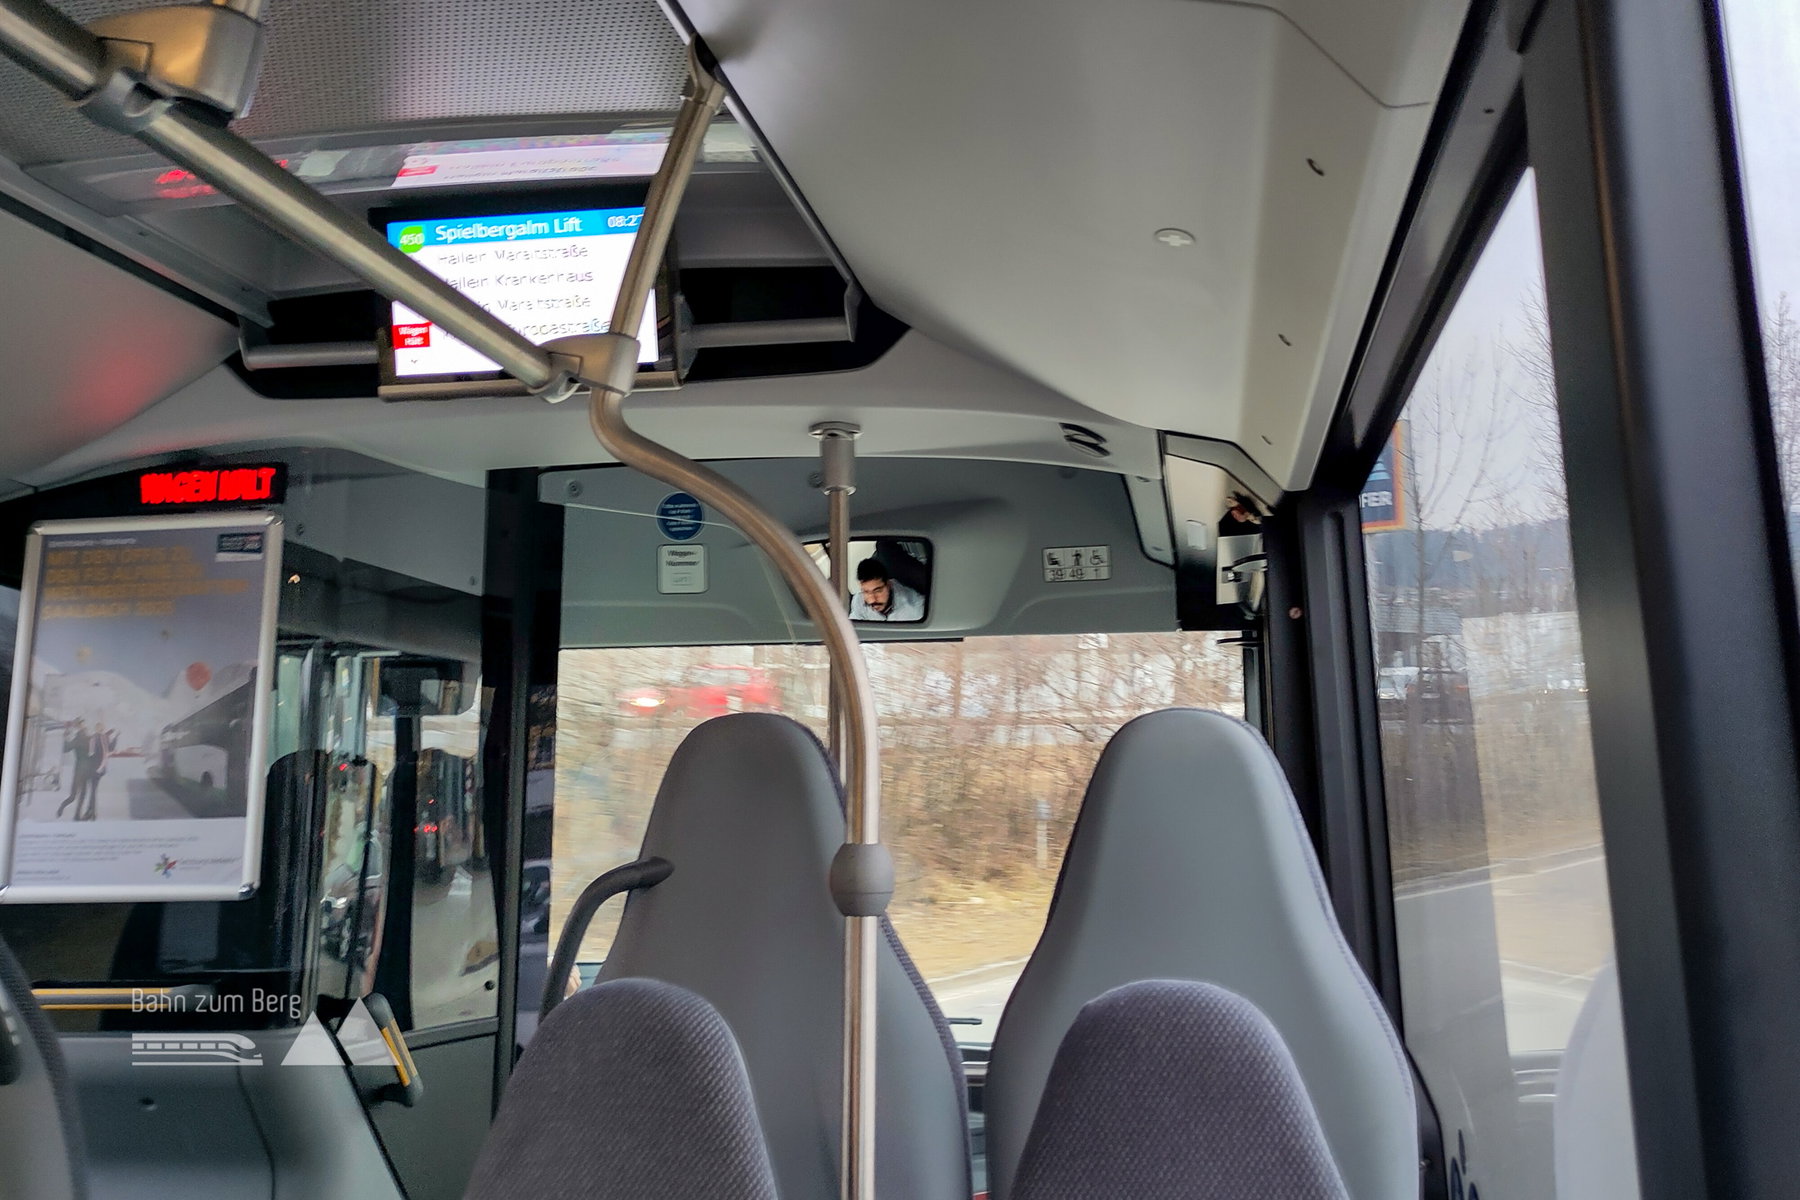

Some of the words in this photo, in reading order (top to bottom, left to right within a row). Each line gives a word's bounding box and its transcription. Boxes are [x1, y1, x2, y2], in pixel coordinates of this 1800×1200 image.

[400, 232, 425, 245] 450
[435, 219, 549, 244] Spielbergalm
[553, 216, 583, 234] Lift
[1359, 491, 1393, 508] FER
